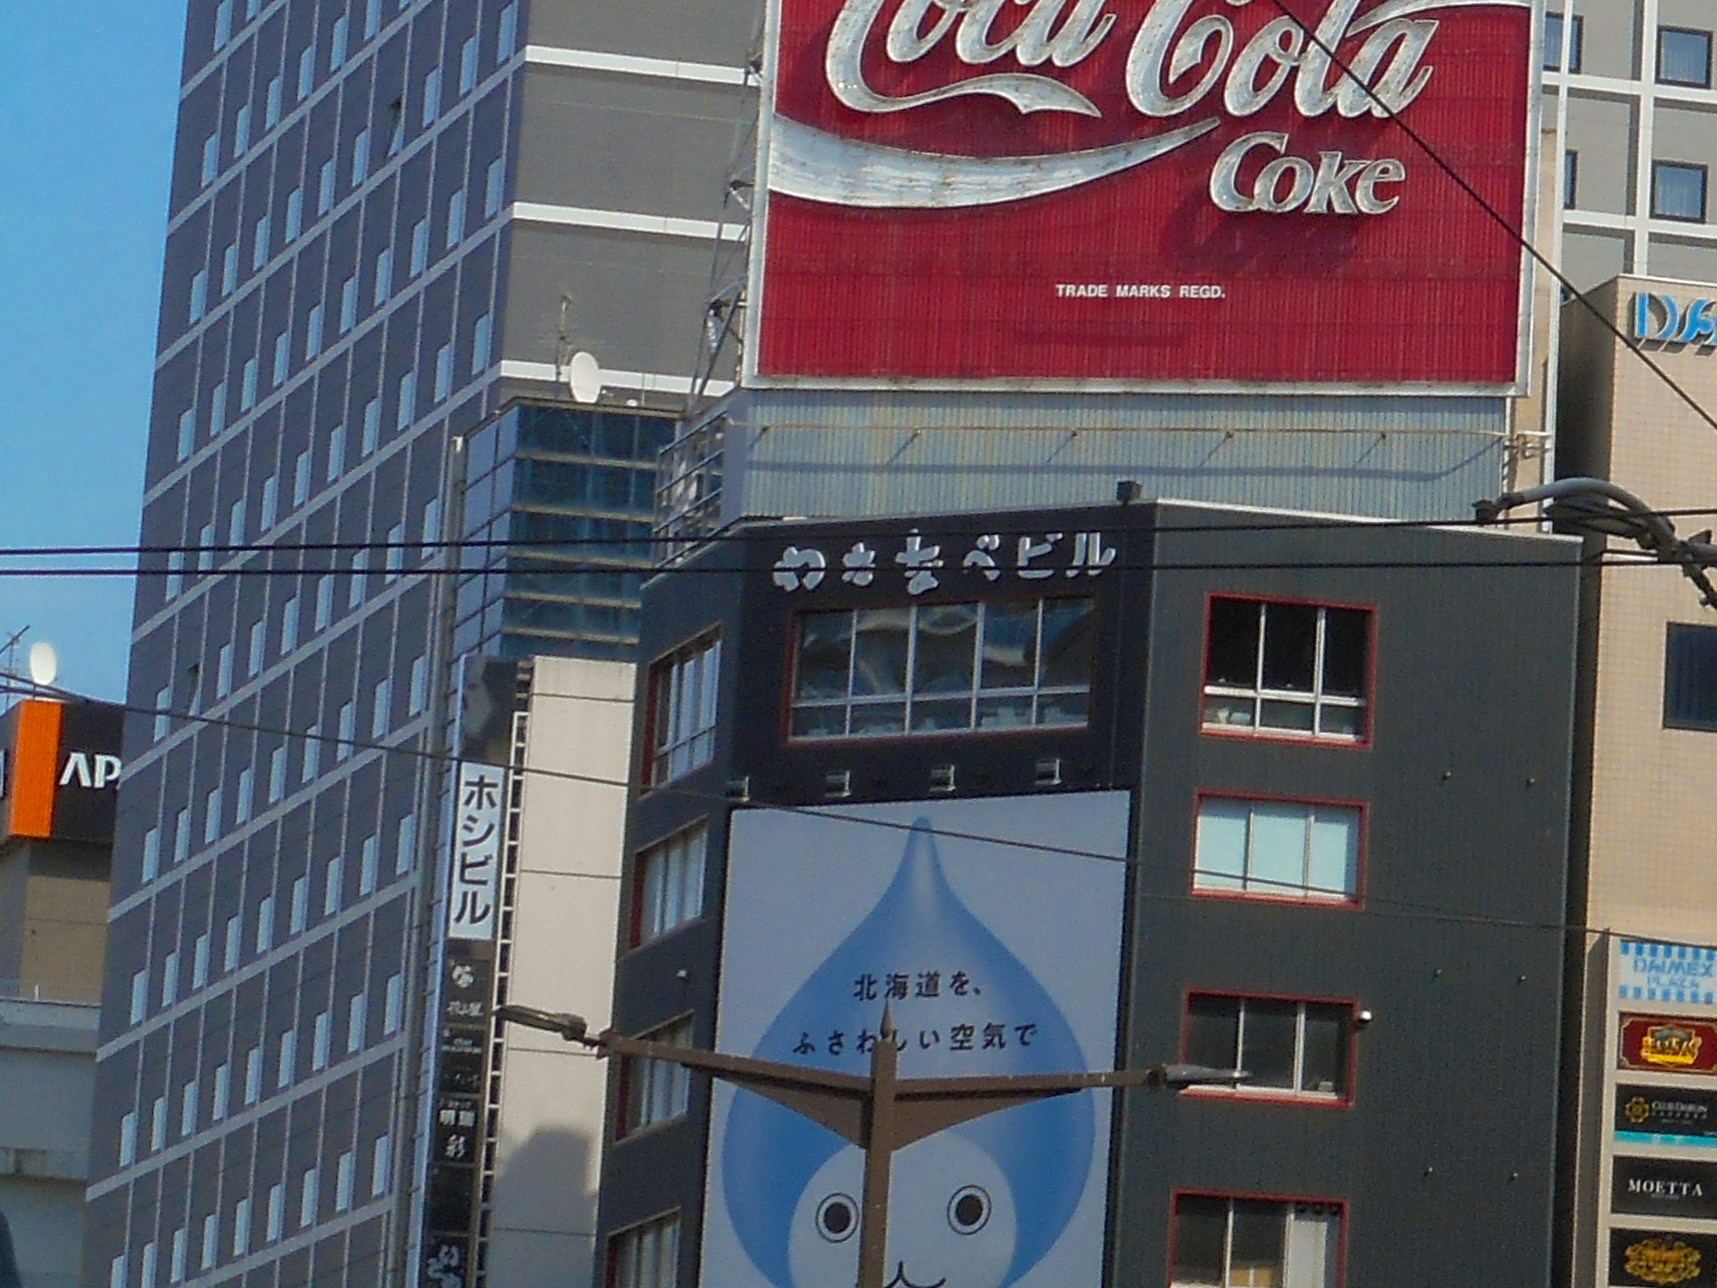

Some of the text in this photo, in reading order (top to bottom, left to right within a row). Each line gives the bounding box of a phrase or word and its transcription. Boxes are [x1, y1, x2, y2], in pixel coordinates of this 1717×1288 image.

[1209, 130, 1407, 215] Coke
[1056, 284, 1227, 300] TRADE MARKS REGD.
[59, 752, 122, 789] AP
[454, 774, 499, 924] ホシビル
[853, 971, 981, 1001] 北海道を、
[1628, 1178, 1702, 1196] MOETTA
